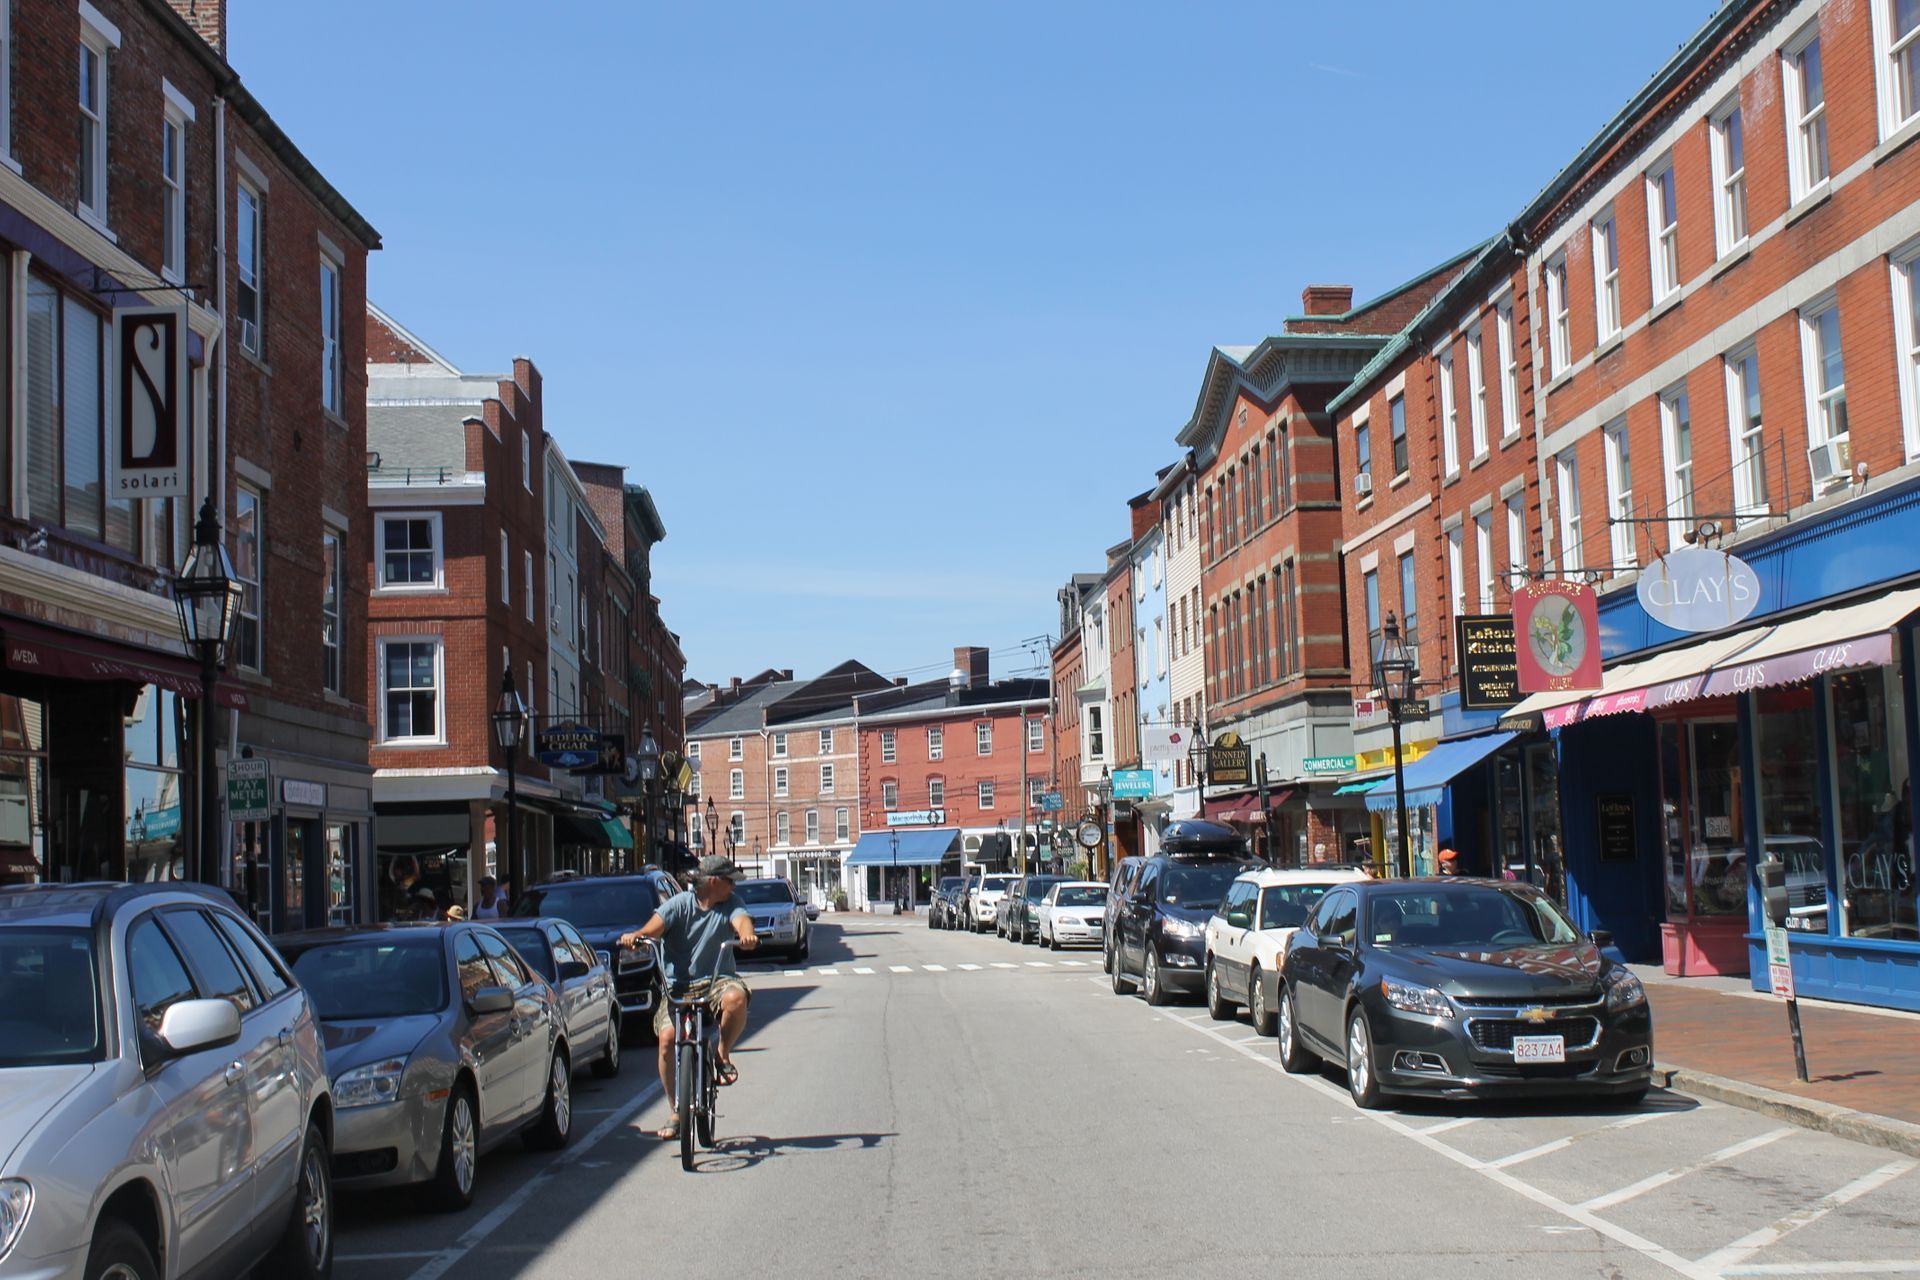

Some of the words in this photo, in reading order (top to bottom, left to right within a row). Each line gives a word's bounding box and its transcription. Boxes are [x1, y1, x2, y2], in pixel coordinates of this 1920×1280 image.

[121, 472, 177, 489] solari
[1648, 574, 1750, 606] CLAY'S
[12, 649, 38, 664] AVEDA
[1478, 682, 1514, 691] SPECIALTY
[542, 733, 595, 743] FEDERAL
[549, 741, 588, 751] CIGAR
[1212, 751, 1247, 760] KENNEDY
[237, 763, 263, 771] HOUR
[1213, 759, 1246, 768] GALLERY
[1303, 758, 1346, 770] COMMERCIAL
[237, 780, 258, 790] PAY
[1115, 781, 1151, 791] JEWELERS
[230, 789, 264, 799] METER
[1850, 852, 1911, 891] CLAY'S
[1517, 1043, 1538, 1057] 823
[1541, 1043, 1562, 1056] ZA4
